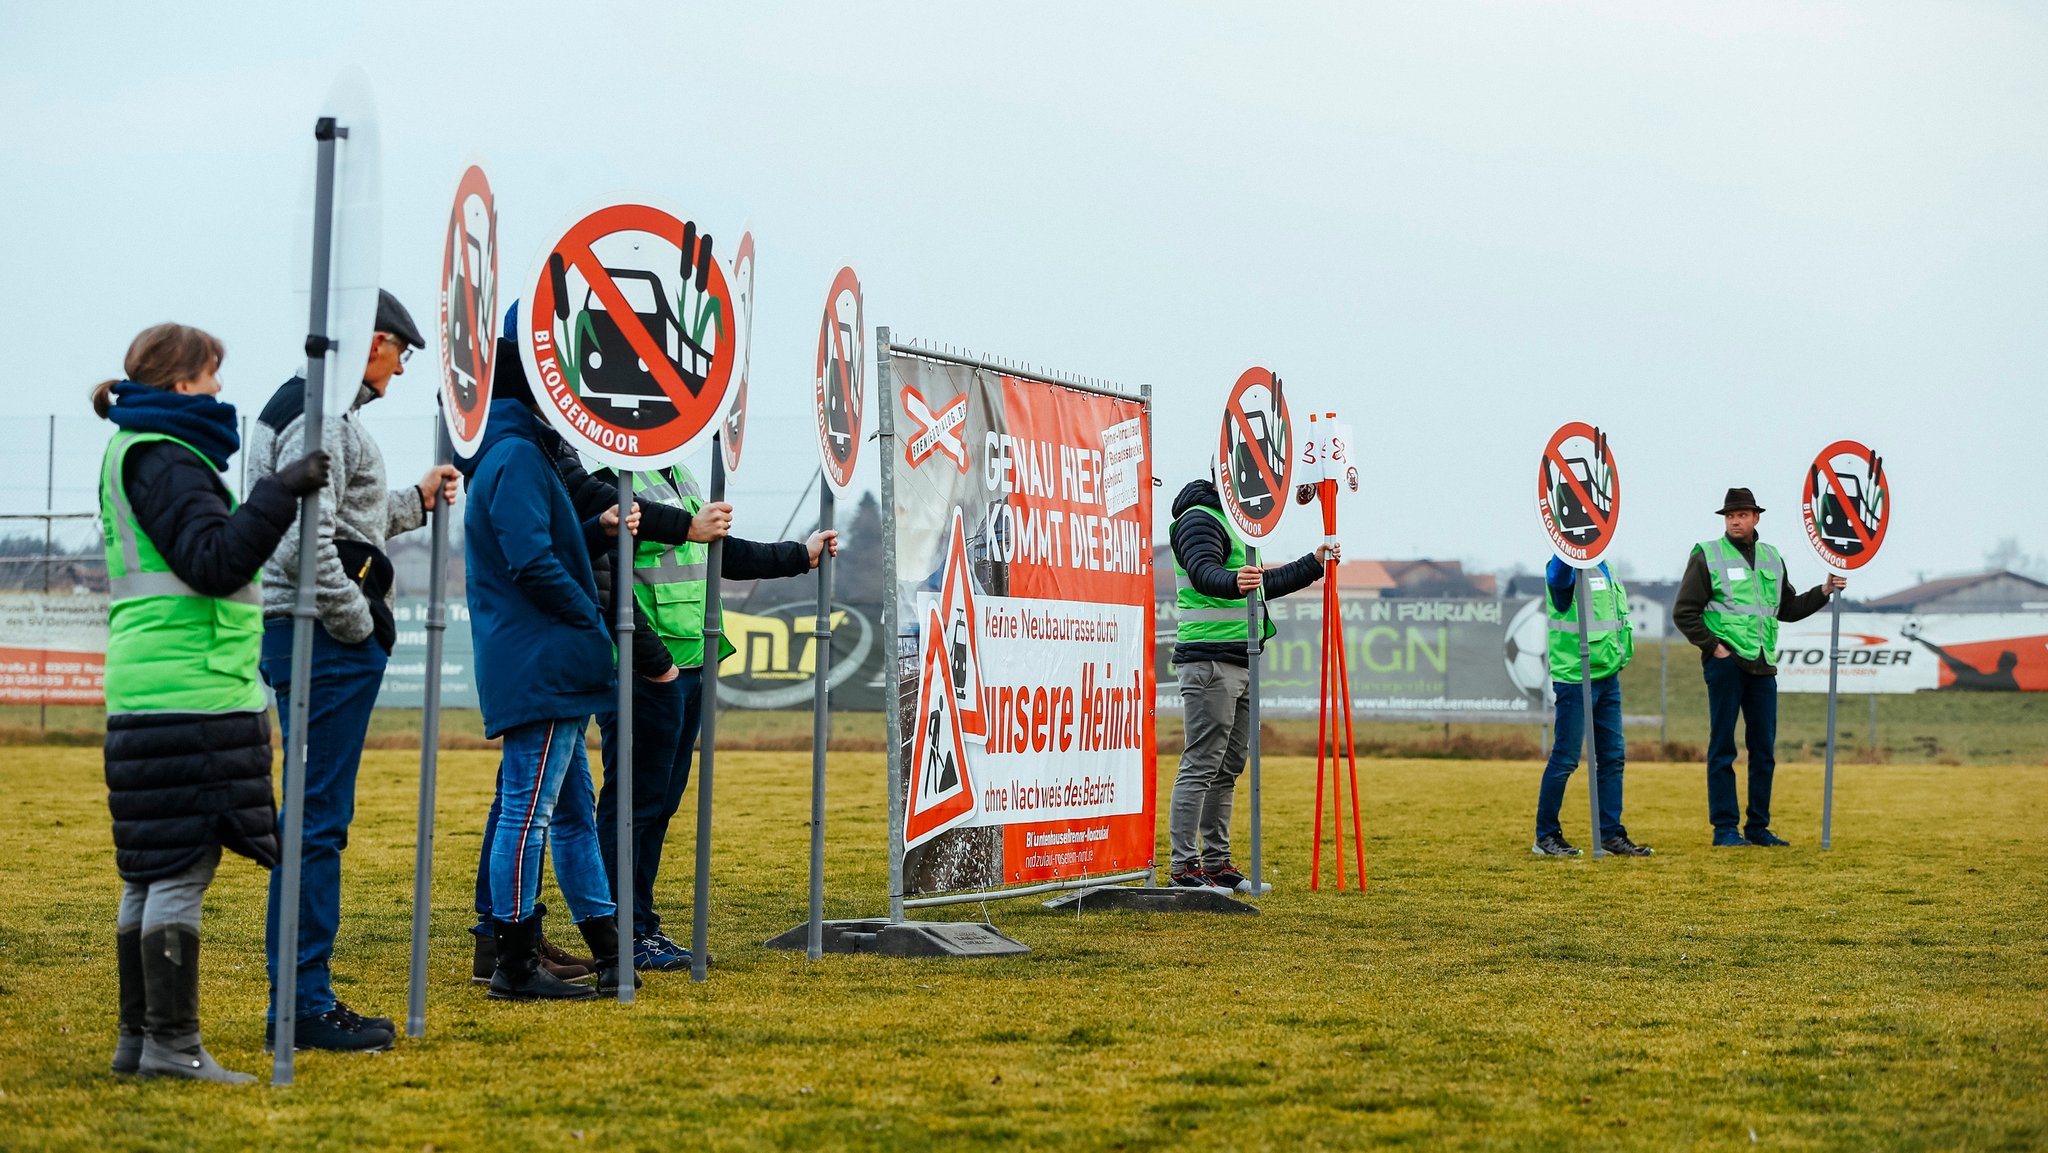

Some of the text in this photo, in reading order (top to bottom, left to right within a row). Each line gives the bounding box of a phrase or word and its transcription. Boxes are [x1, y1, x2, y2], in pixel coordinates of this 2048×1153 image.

[534, 330, 639, 453] BI KOLBERMOOR
[817, 377, 844, 484] BI KOLBERMOOR
[984, 431, 1103, 505] GENAU HIER
[1221, 462, 1263, 535] BI KOLBERMOOR
[986, 503, 1147, 576] KOMMT DIE BAHN:
[1540, 498, 1588, 559] BI KOLBERMOOR
[1803, 503, 1848, 568] BI KOLBERMOOR
[985, 606, 1118, 642] Keine Neubautrasse durch
[985, 662, 1141, 754] unsere Heimat
[985, 775, 1115, 813] ohne Nachweis des Bedarfs
